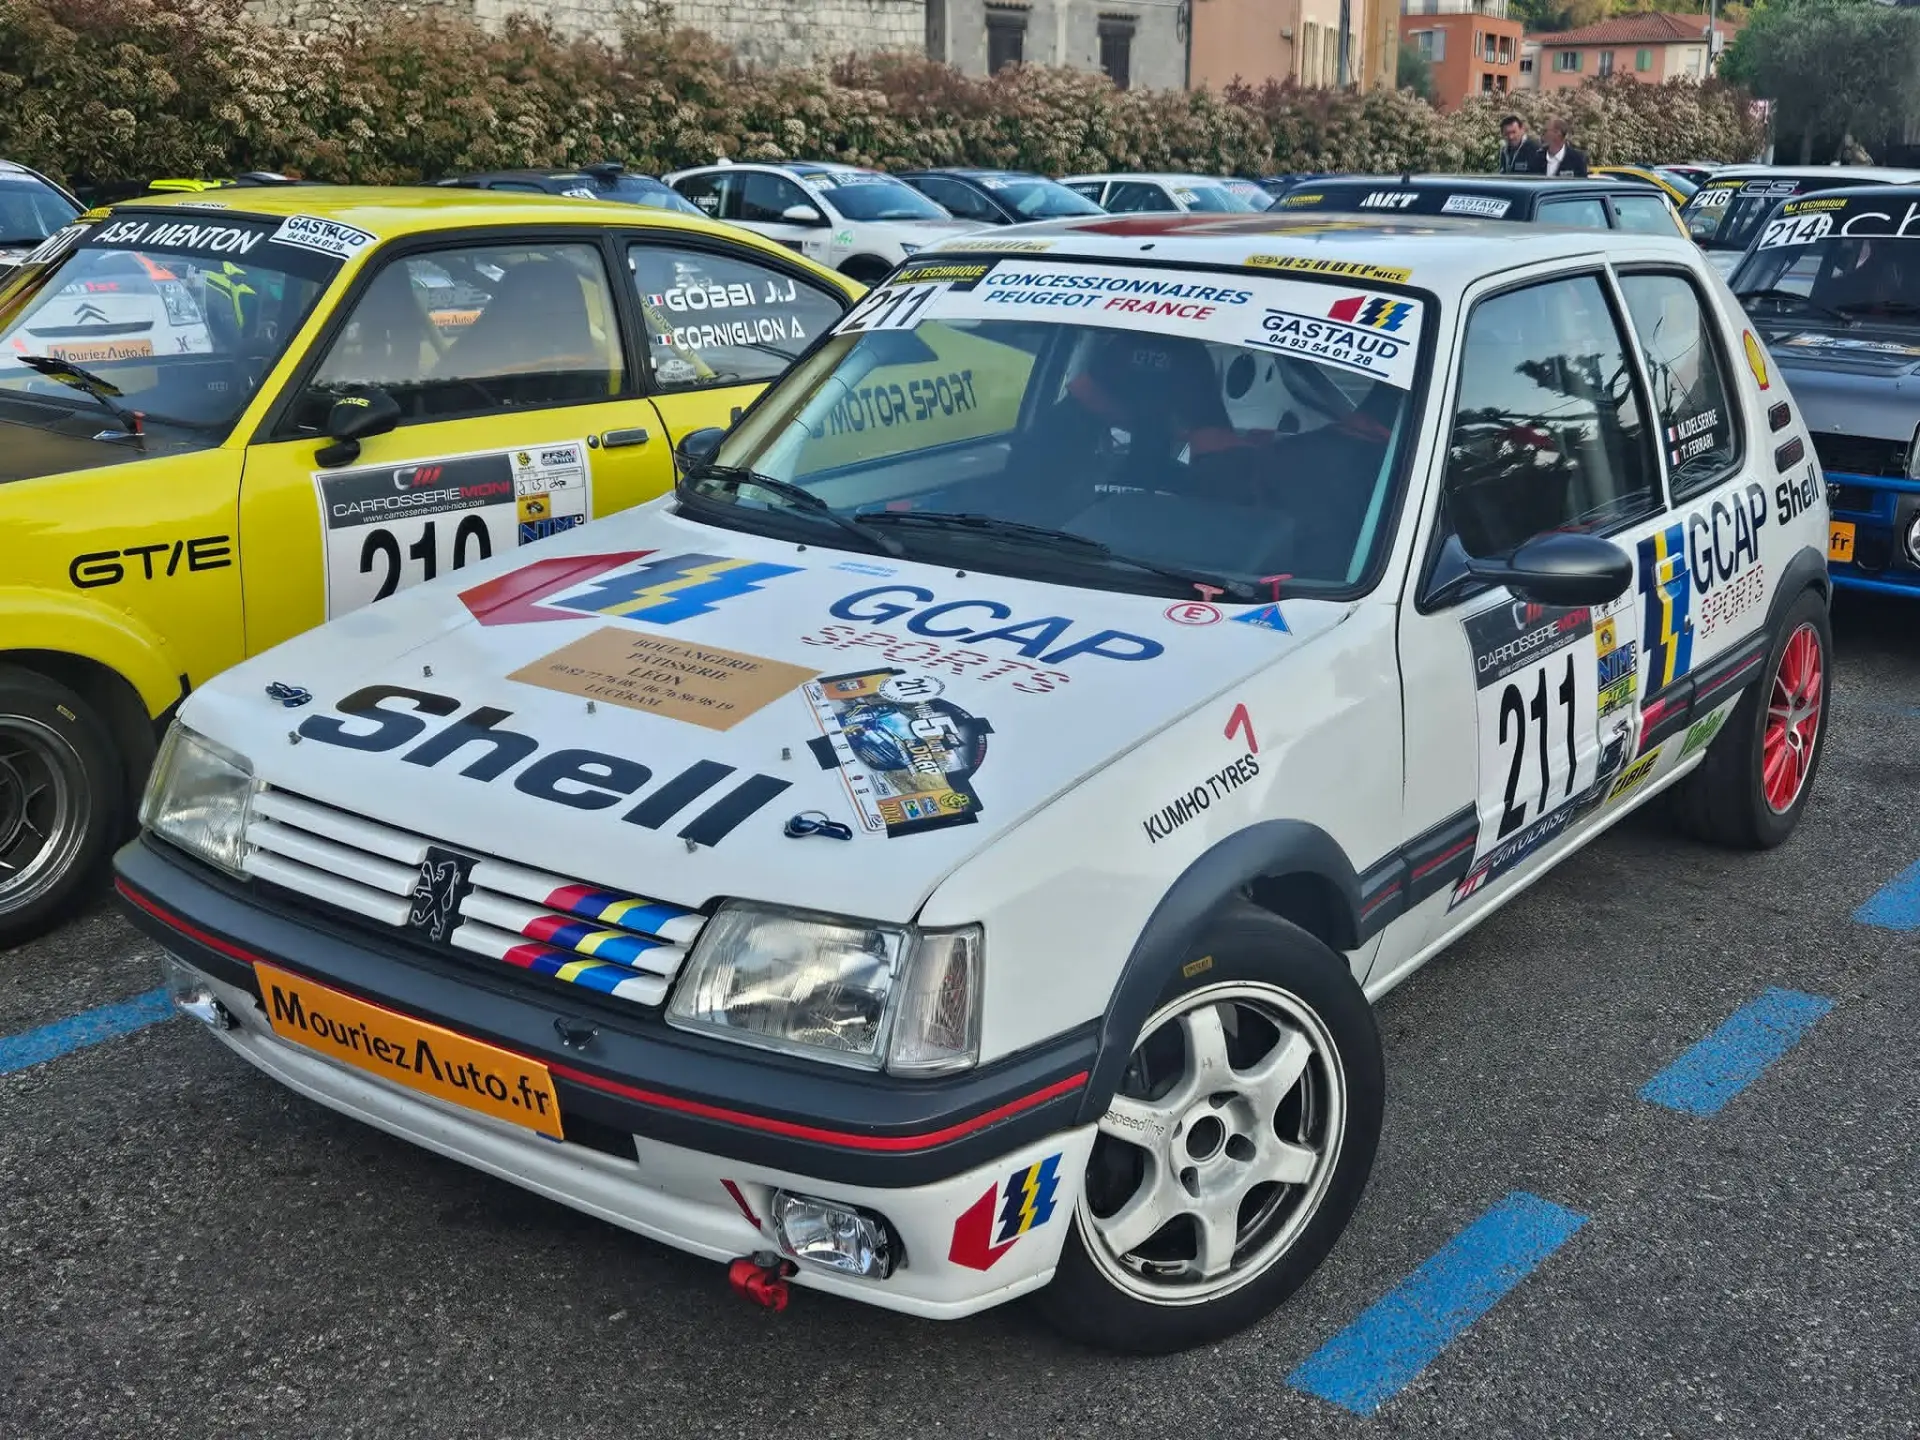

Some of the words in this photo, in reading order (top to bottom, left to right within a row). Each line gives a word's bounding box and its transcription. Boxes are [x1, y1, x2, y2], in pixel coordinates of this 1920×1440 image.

[1691, 191, 1730, 207] 216
[92, 221, 149, 243] ASA
[142, 223, 264, 254] MENTON
[287, 216, 368, 247] GASTAUD
[1760, 217, 1819, 248] 214
[917, 265, 989, 278] TECHNIQUE
[985, 273, 1253, 305] CONCESSIONNAIRES
[1373, 269, 1405, 282] NICE
[664, 282, 757, 312] GOBBI
[841, 285, 939, 331] 211
[984, 290, 1102, 308] PEUGEOT
[1103, 296, 1216, 321] FRANCE
[673, 317, 787, 351] CORNIGLION
[791, 315, 806, 339] A
[1262, 315, 1400, 360] GASTAUD
[1269, 333, 1287, 345] 04
[1290, 336, 1308, 349] 93
[1311, 343, 1330, 355] 54
[1332, 347, 1350, 360] 01
[1352, 353, 1374, 367] 28
[908, 369, 978, 421] SPORT
[1775, 463, 1820, 526] Shell
[1688, 482, 1768, 595] GCAP
[69, 535, 232, 589] GT/E
[1183, 605, 1207, 620] E
[1700, 564, 1764, 640] SPORTS
[828, 584, 1166, 665] GCAP
[632, 639, 759, 672] BOULANGERIE
[801, 624, 1071, 695] SPORTS
[895, 677, 933, 697] 211
[1497, 652, 1578, 842] 211
[299, 684, 795, 848] Shell
[1142, 785, 1211, 844] KUMHO
[1205, 752, 1260, 800] TYRES
[270, 984, 551, 1117] MouriezAuto.fr
